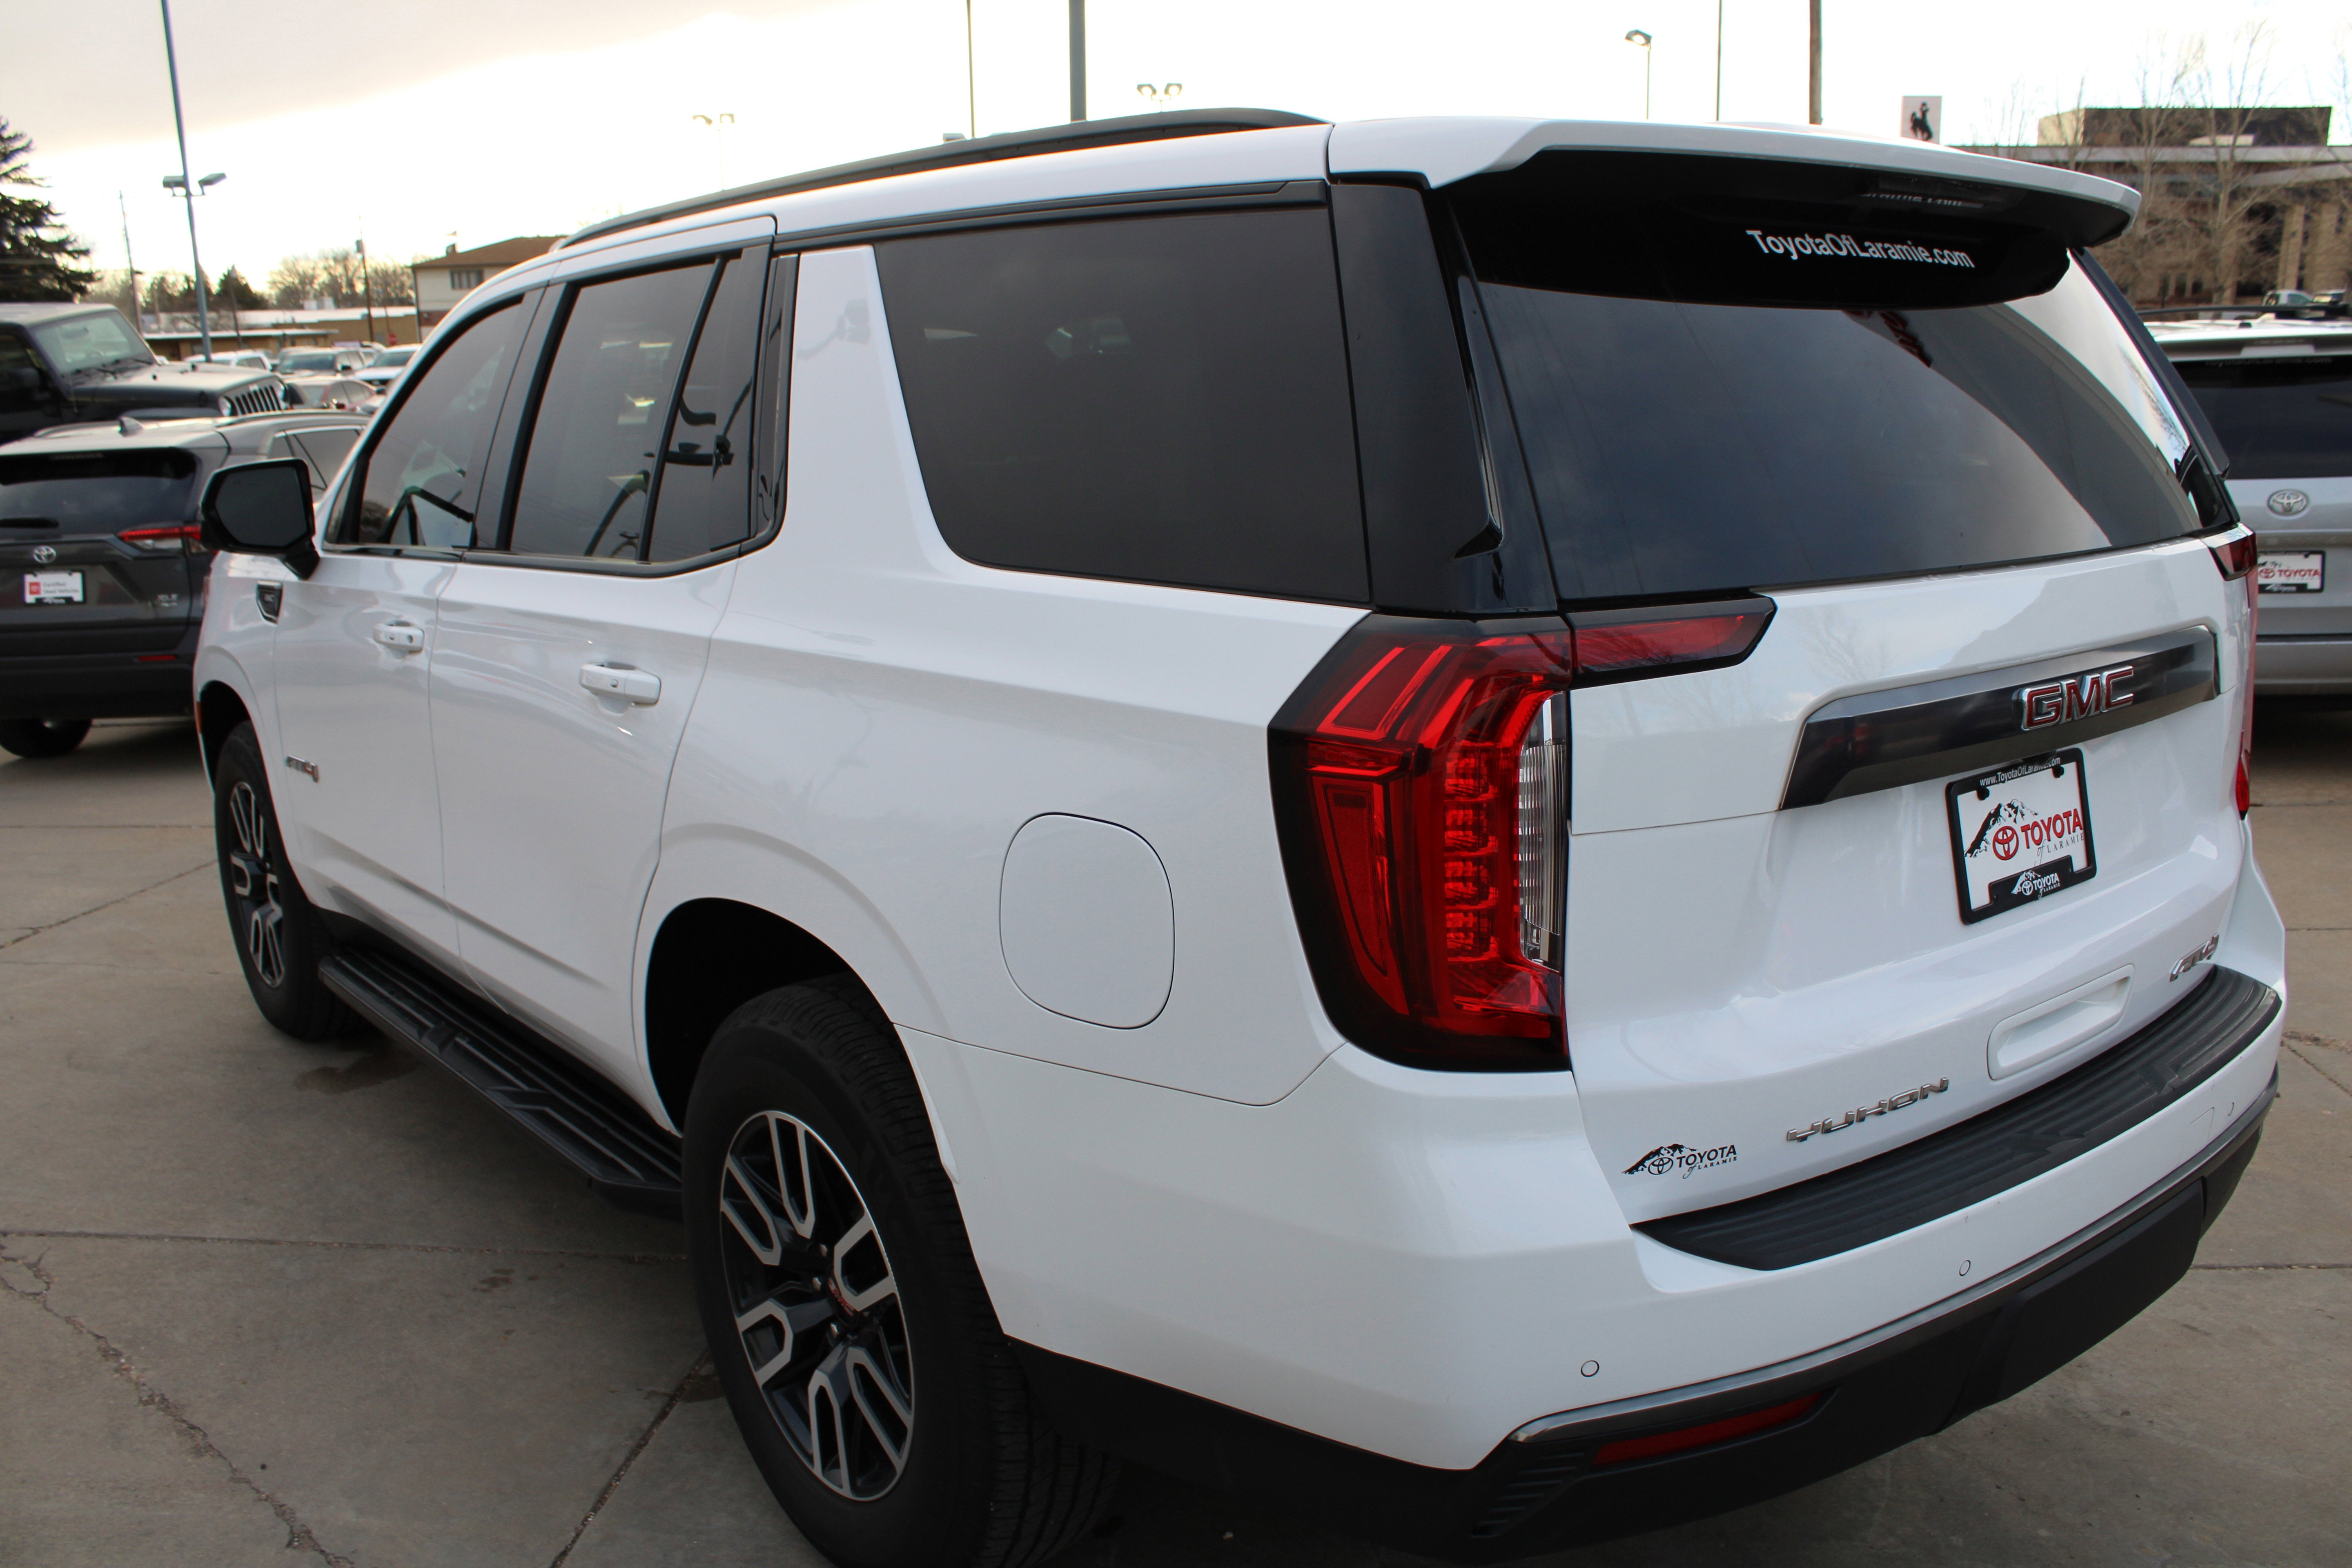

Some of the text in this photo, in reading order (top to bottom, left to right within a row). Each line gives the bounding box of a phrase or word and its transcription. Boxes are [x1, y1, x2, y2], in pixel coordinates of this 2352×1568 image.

[1746, 229, 1975, 268] ToyotaOfLaramie.com
[2277, 569, 2320, 577] TOYOTA
[2021, 665, 2134, 731] GMC
[1980, 757, 2060, 786] www.ToyotaOfLarame.com
[2021, 808, 2083, 849] TOYOTA
[2047, 833, 2084, 853] LARAMIE
[2033, 873, 2060, 891] TOYOTA
[1786, 1077, 1949, 1143] YUKON
[1676, 1144, 1737, 1168] TOYOTA
[1682, 1156, 1737, 1179] of LARAMIE
